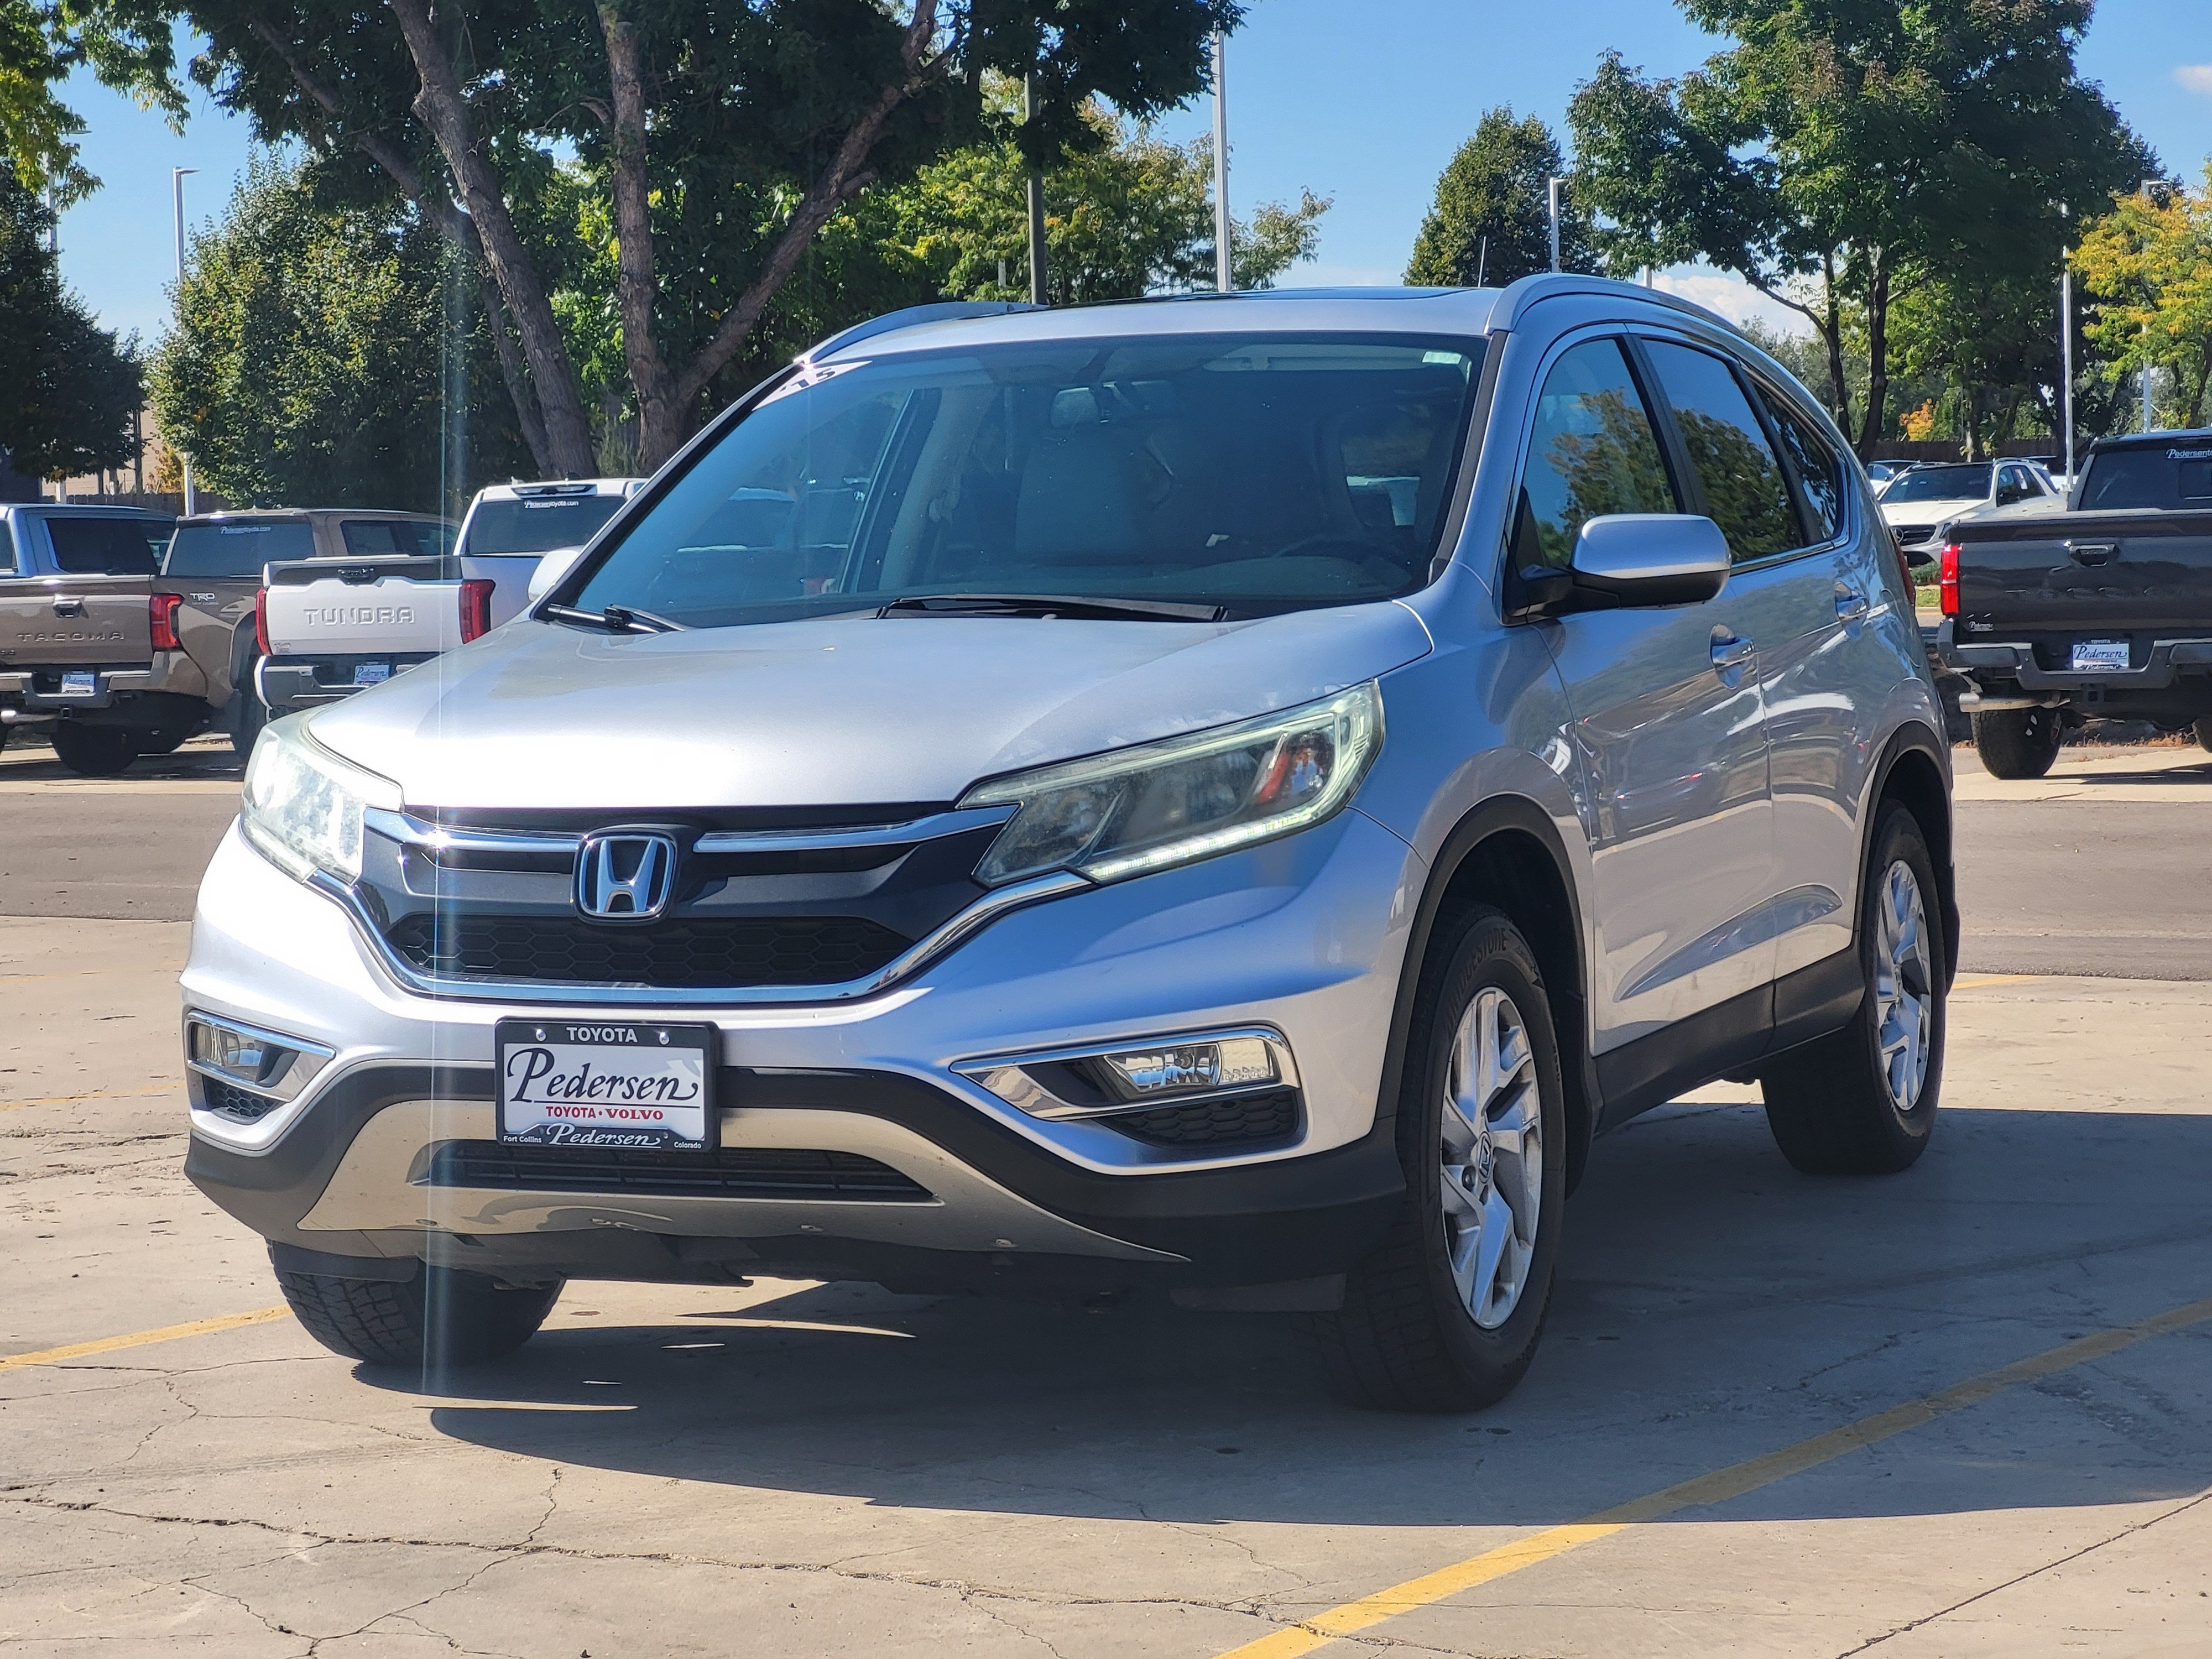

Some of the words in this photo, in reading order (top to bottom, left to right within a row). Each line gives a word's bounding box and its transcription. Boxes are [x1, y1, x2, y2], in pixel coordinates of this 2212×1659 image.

[304, 607, 414, 626] TUNDRA
[16, 632, 124, 642] TACOMA
[2074, 645, 2127, 659] Pedersen
[566, 1026, 638, 1043] TOYOTA
[507, 1047, 698, 1103] Pedersen
[546, 1123, 661, 1145] Pedersen
[674, 1141, 702, 1149] Colorado
